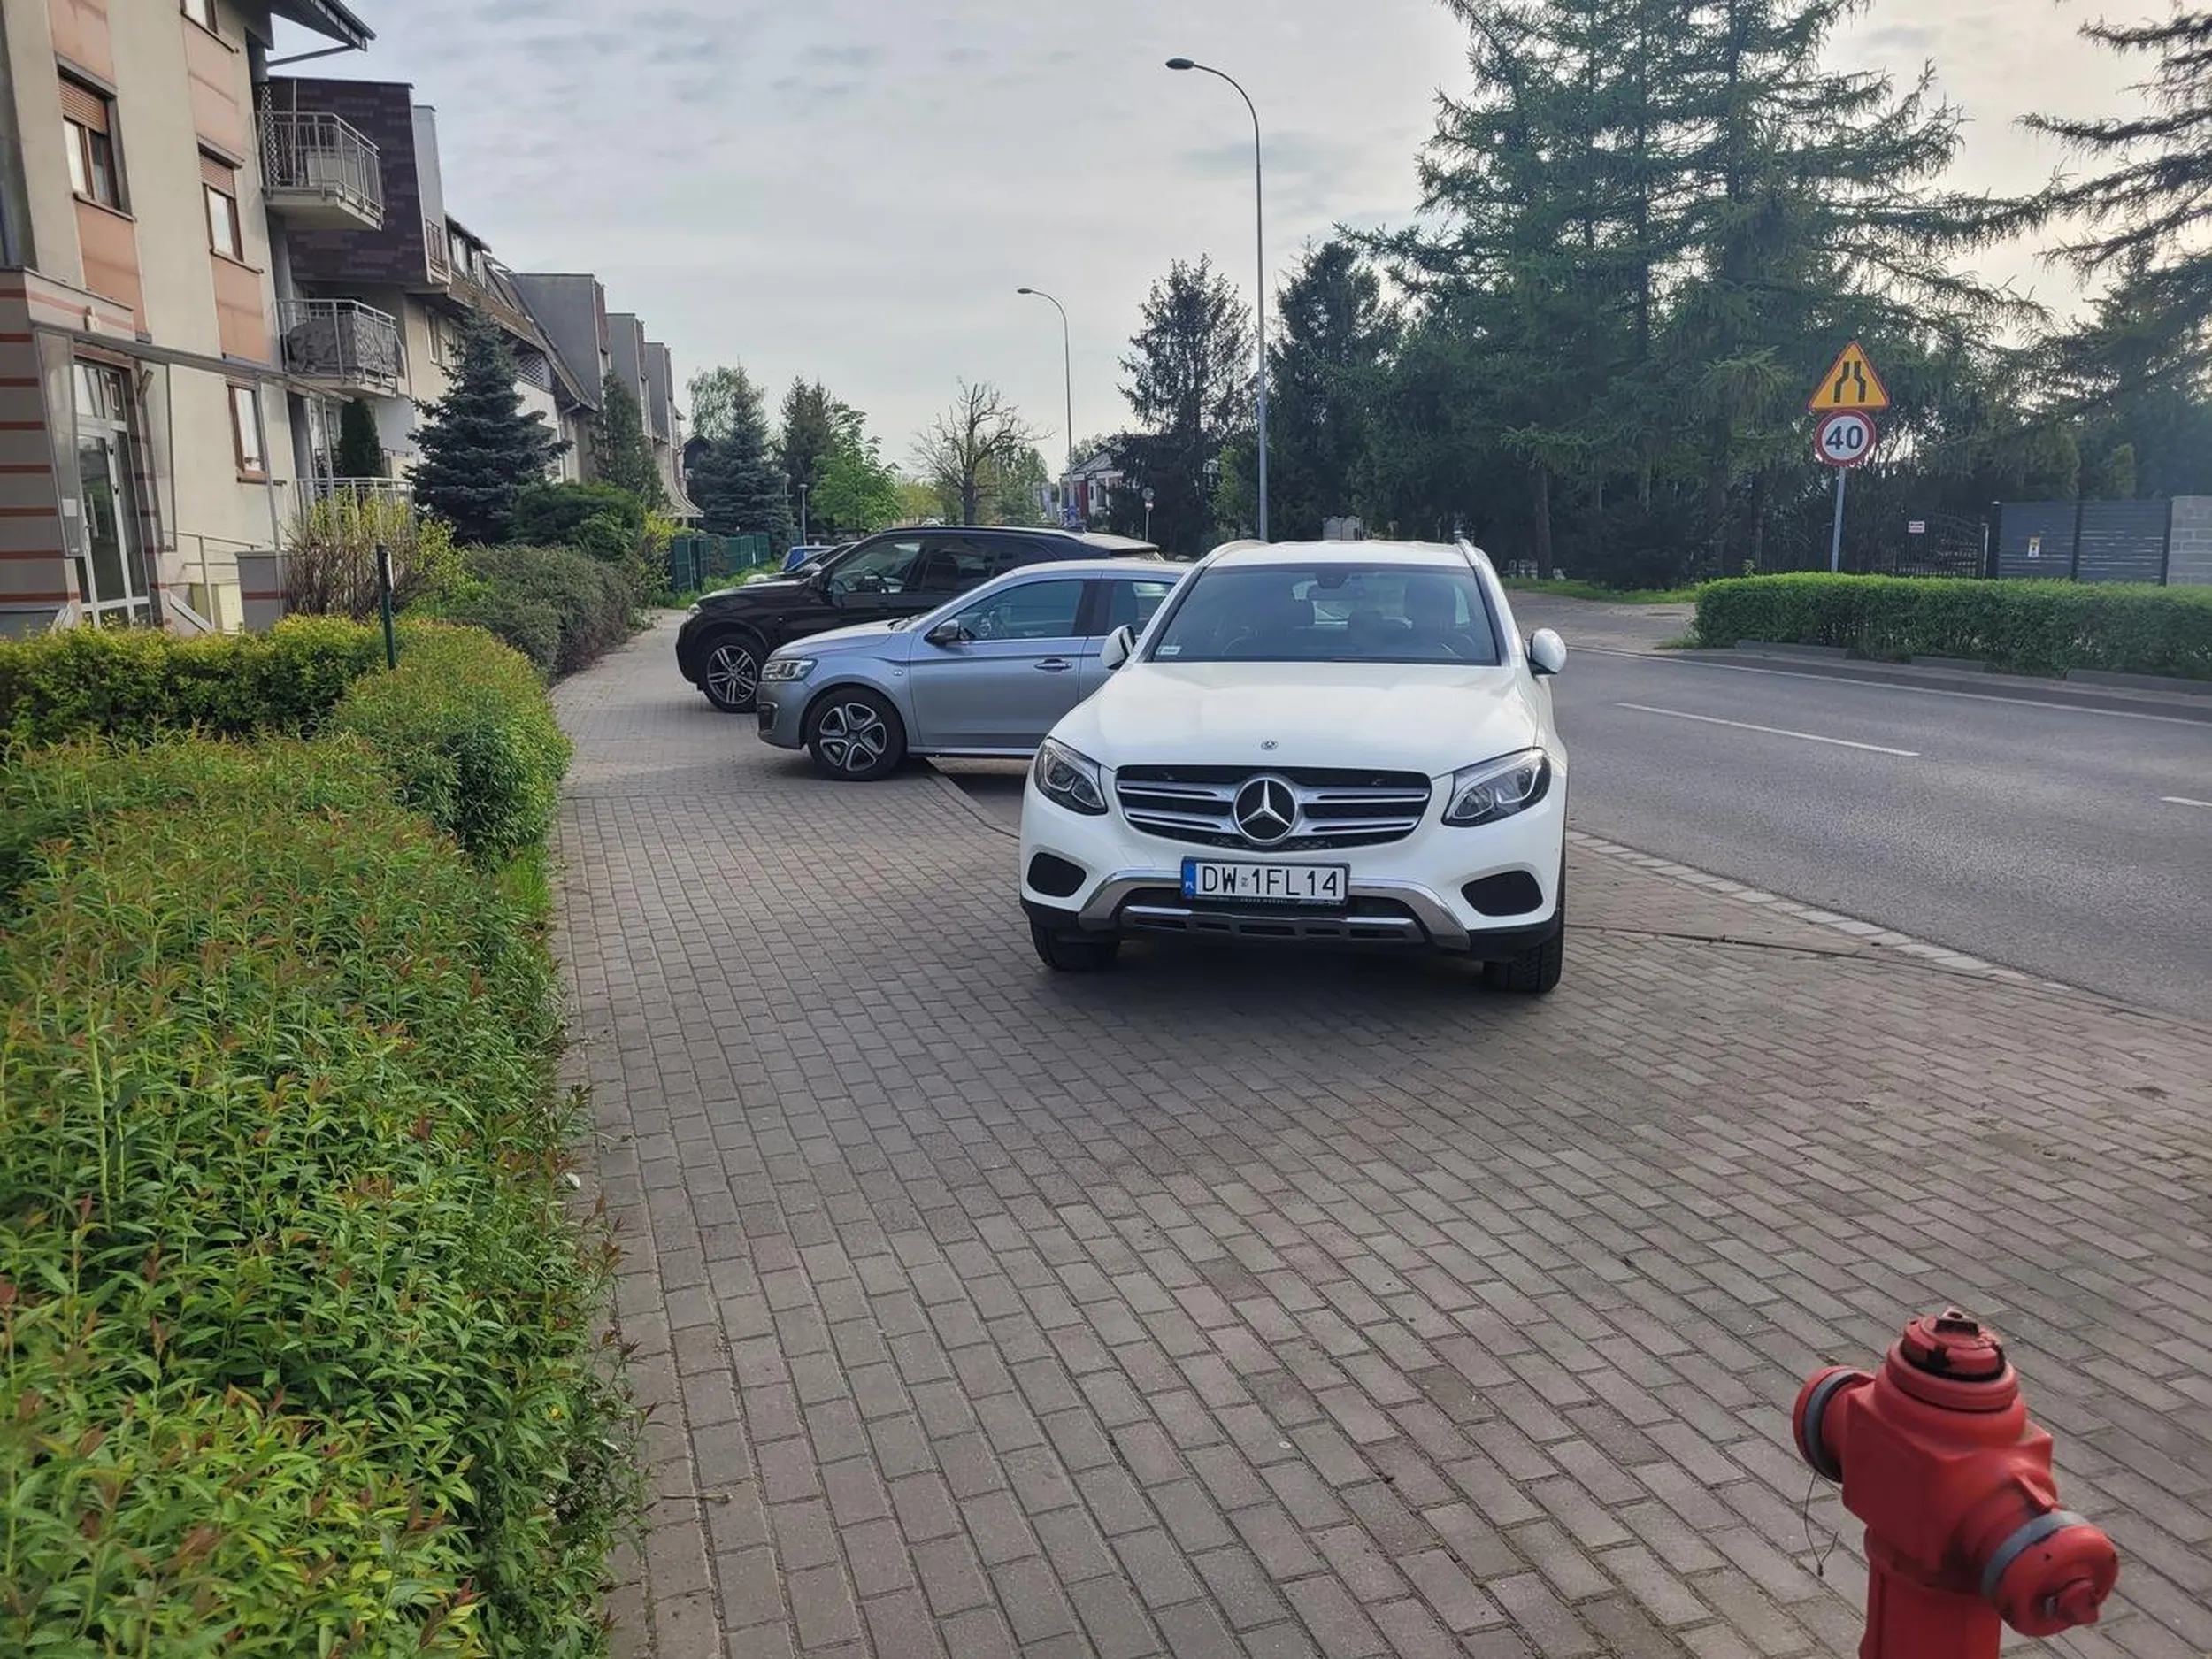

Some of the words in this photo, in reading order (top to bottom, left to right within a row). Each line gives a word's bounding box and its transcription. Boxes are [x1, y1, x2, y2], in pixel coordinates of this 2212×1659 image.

[1825, 426, 1863, 450] 40
[1202, 866, 1237, 894] DW
[1252, 868, 1337, 896] 1FL14
